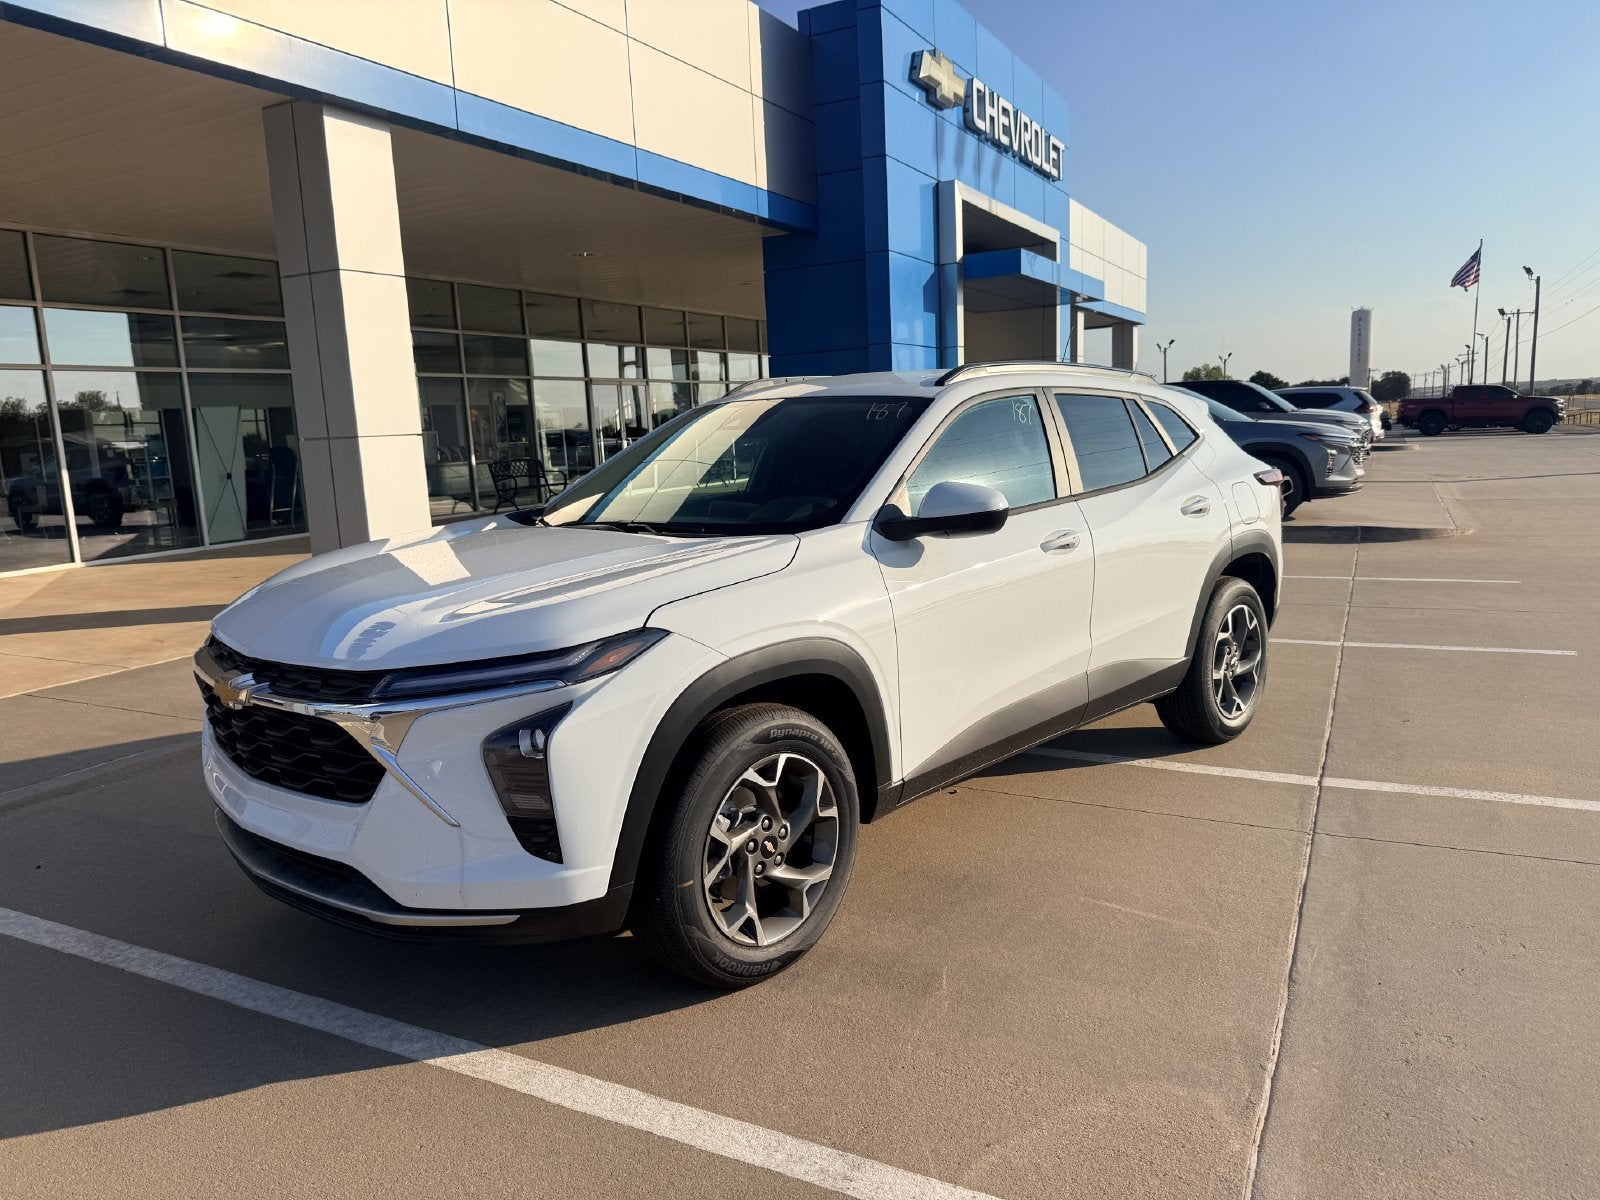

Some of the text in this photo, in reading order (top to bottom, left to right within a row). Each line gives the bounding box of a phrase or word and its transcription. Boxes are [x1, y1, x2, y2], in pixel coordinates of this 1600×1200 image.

[969, 77, 1066, 181] CHEVROLET
[866, 401, 909, 421] 187
[1011, 400, 1033, 426] 187
[769, 728, 818, 741] Dynapro
